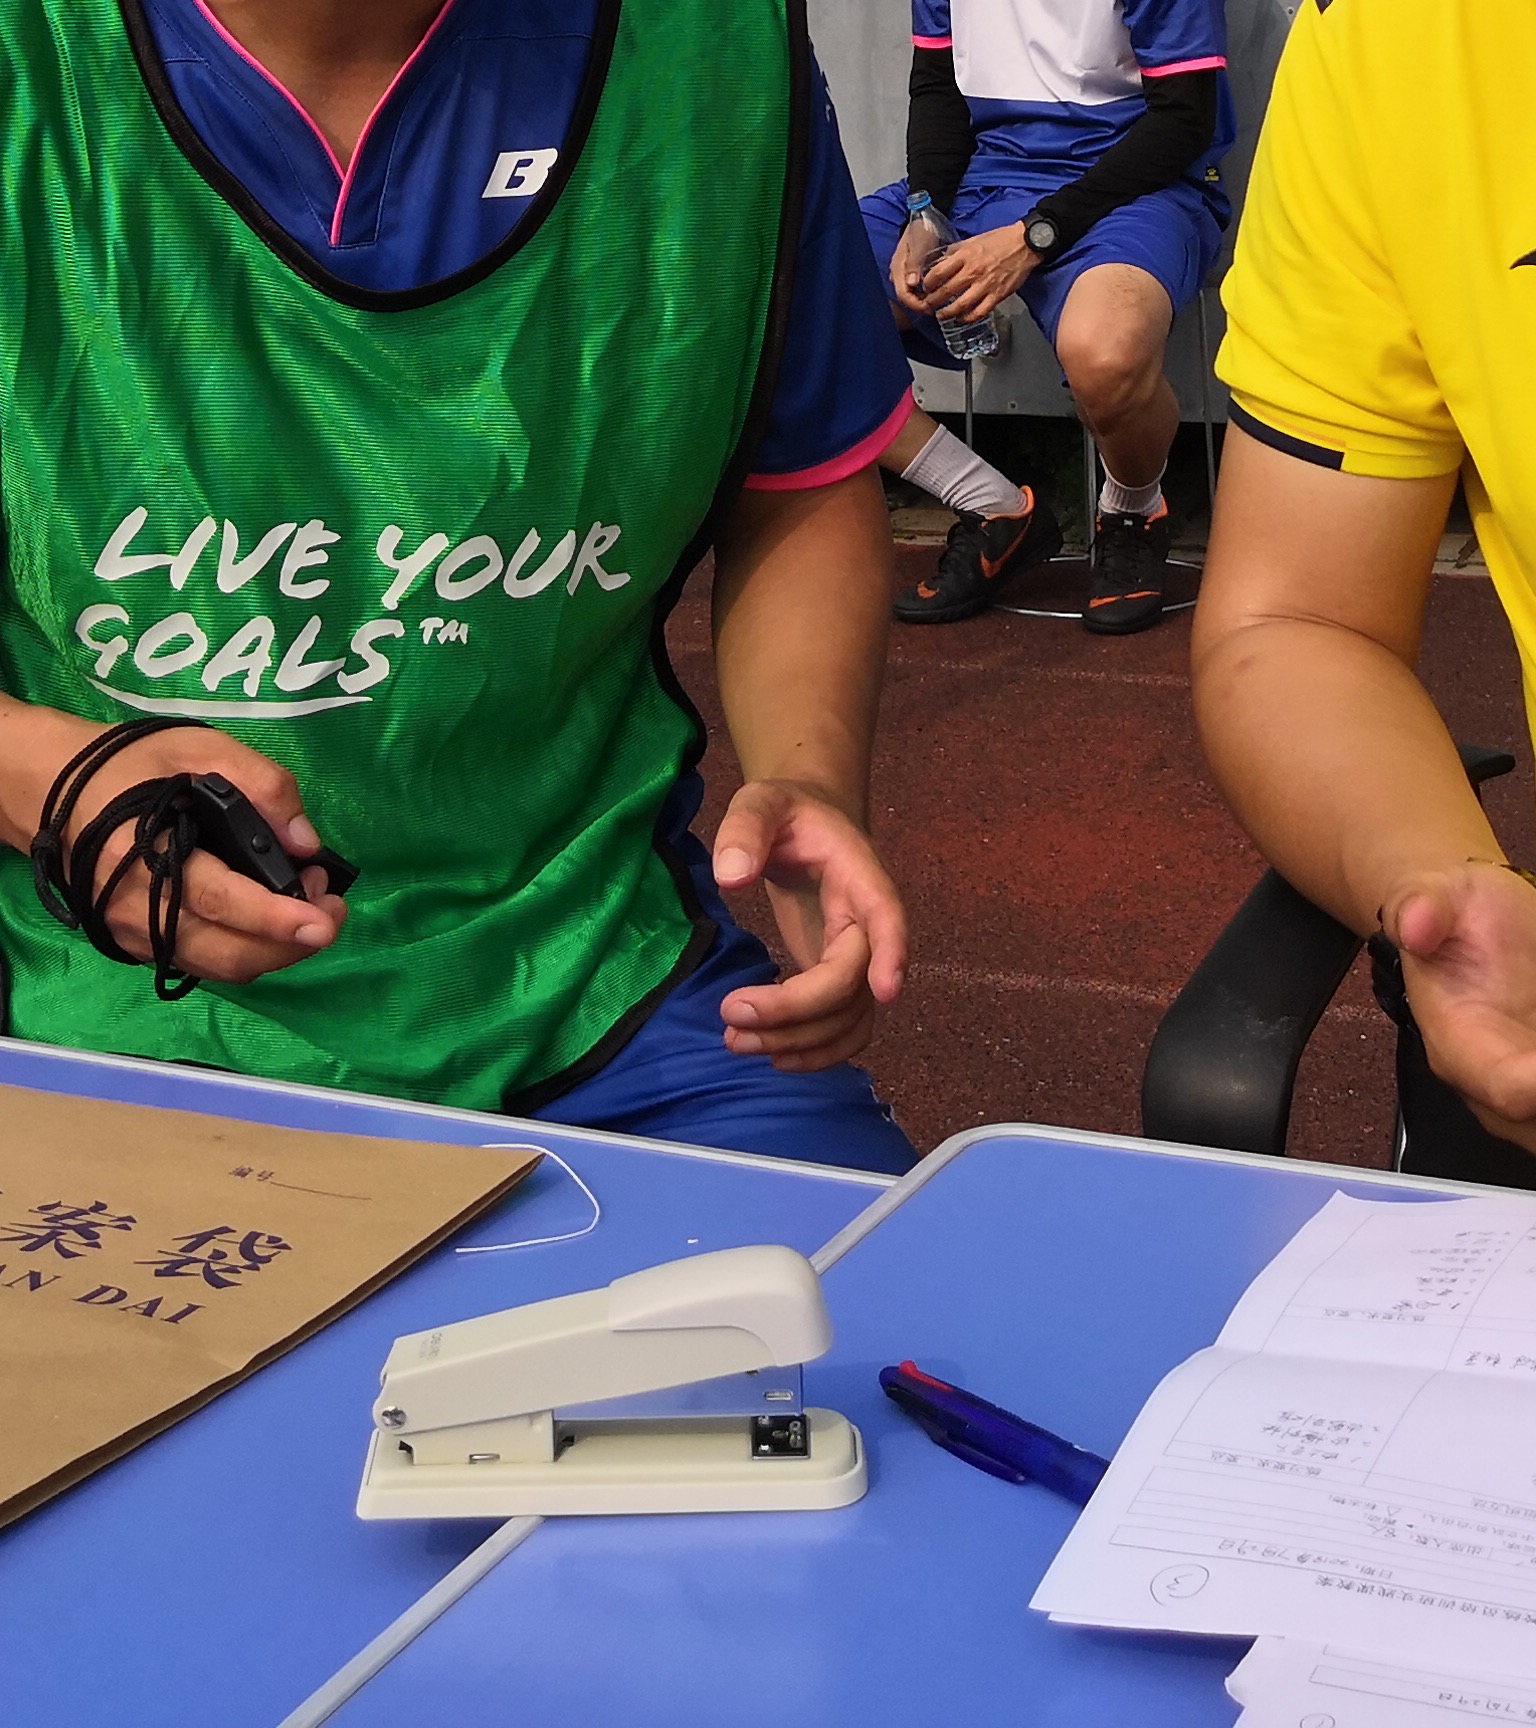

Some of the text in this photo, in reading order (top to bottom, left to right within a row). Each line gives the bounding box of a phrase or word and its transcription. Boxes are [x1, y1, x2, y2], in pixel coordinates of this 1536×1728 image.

[94, 506, 632, 610] LIVE YOUR
[71, 1283, 207, 1326] DAI
